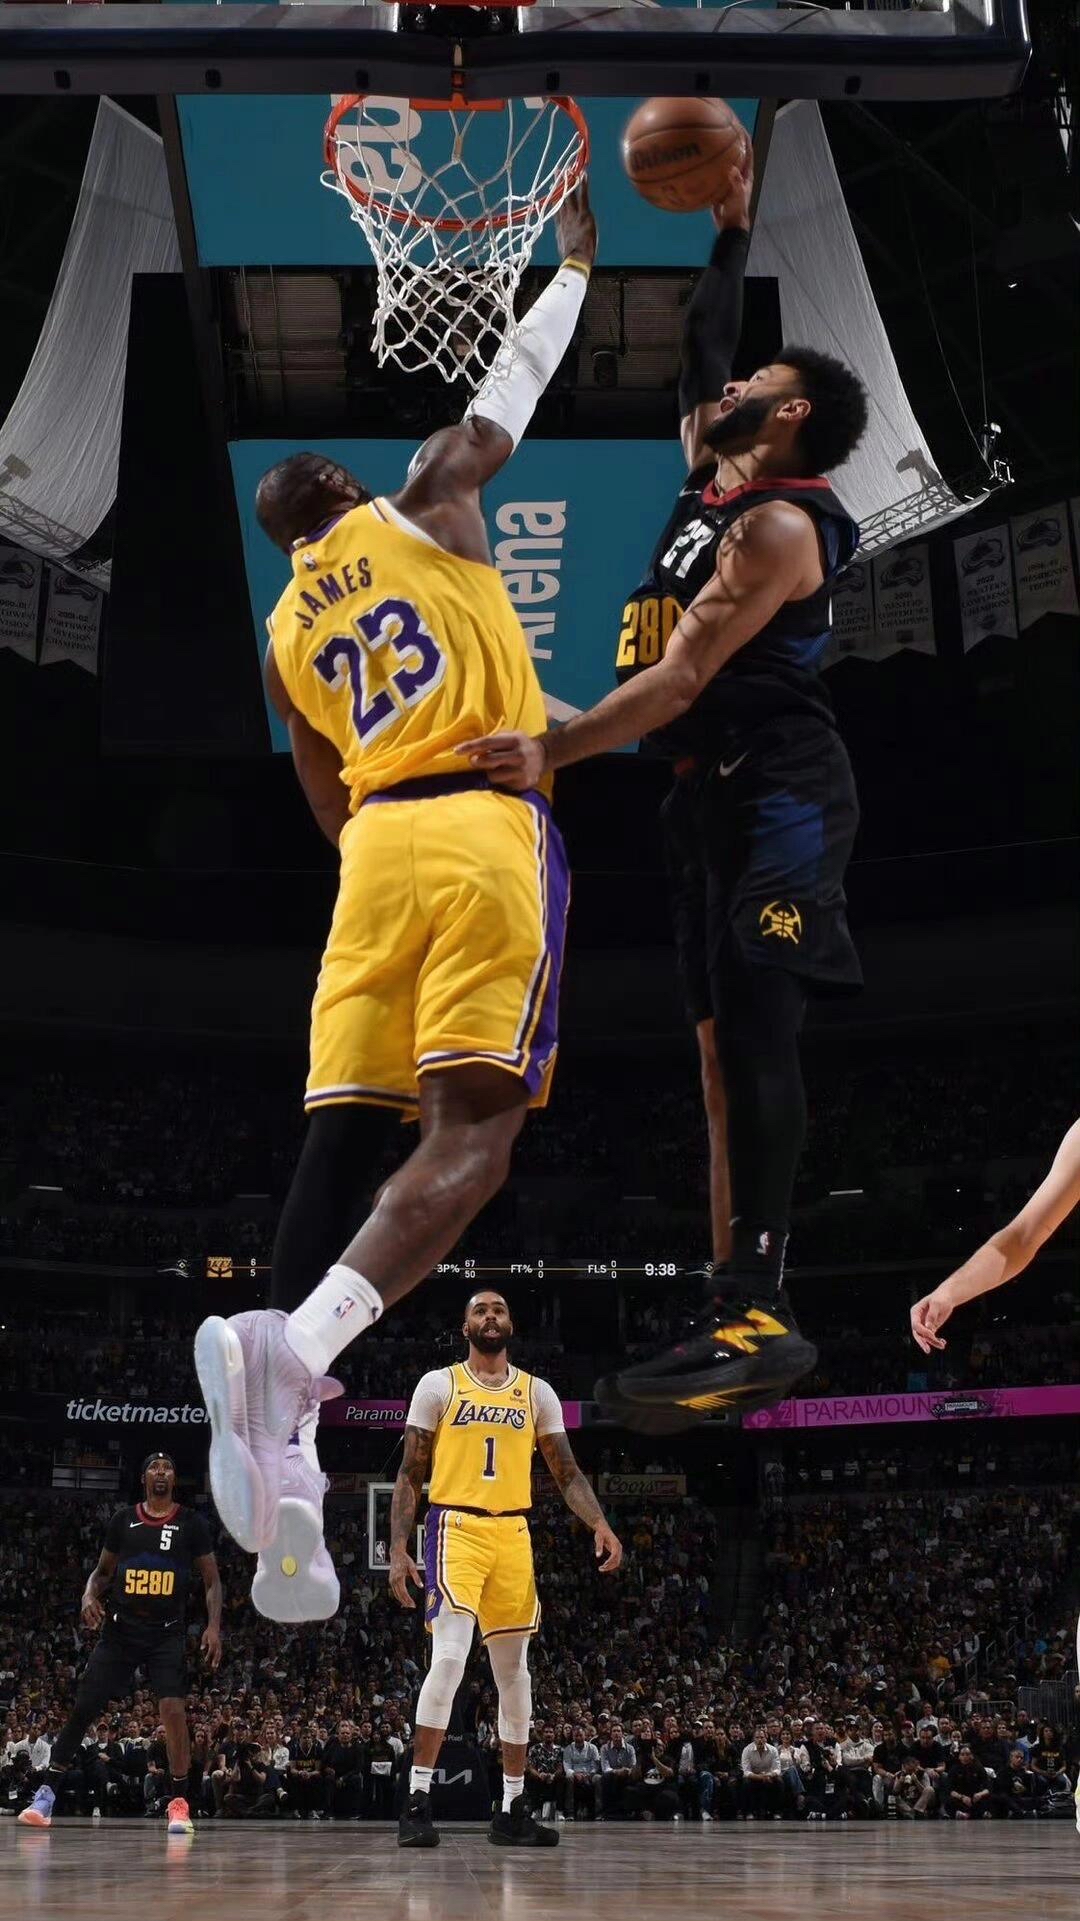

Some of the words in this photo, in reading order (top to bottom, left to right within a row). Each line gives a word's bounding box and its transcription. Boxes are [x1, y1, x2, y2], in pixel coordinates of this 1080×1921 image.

[660, 518, 716, 579] 27
[295, 556, 373, 630] JAMES
[311, 595, 447, 751] 23
[464, 1259, 476, 1268] 67
[538, 1260, 544, 1268] 0
[611, 1260, 617, 1268] 0
[250, 1269, 256, 1277] 5
[437, 1264, 460, 1274] 3P%
[510, 1264, 533, 1274] FT%
[587, 1264, 608, 1274] FLS
[644, 1263, 677, 1276] 9:38
[464, 1270, 476, 1279] 50
[538, 1270, 544, 1279] 0
[611, 1270, 617, 1279] 0
[345, 1406, 407, 1420] Paramo
[450, 1399, 527, 1430] LAKERS
[482, 1436, 497, 1479] 1
[159, 1530, 173, 1550] 5
[125, 1568, 175, 1596] 5280
